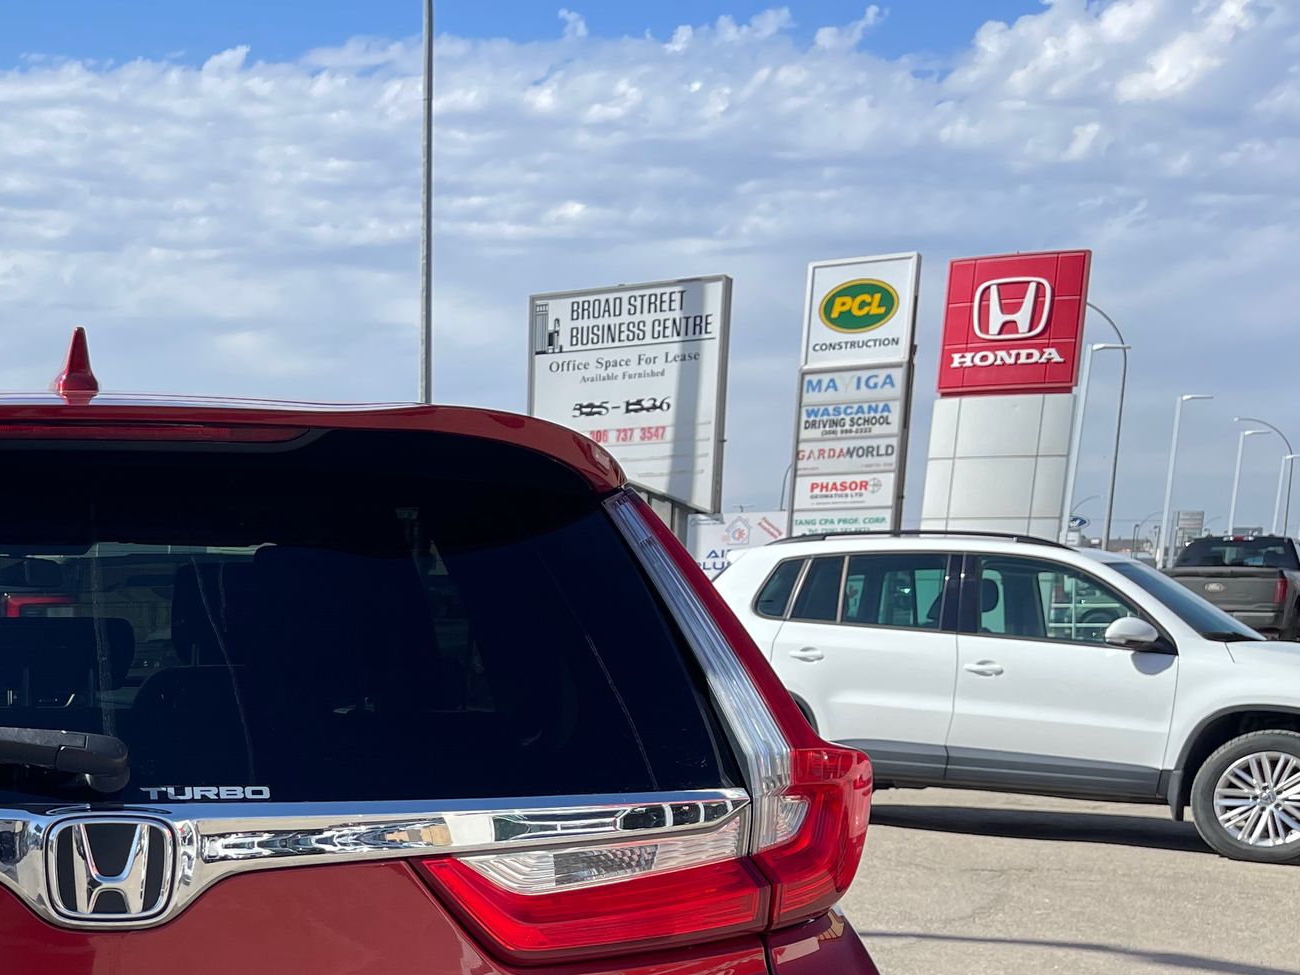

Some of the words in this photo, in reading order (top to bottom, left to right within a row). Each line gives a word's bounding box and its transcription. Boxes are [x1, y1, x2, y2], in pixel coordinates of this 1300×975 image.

[570, 297, 622, 321] BROAD
[627, 290, 687, 315] STREET
[830, 292, 886, 319] PCL
[570, 320, 646, 347] BUSINESS
[651, 313, 713, 340] CENTRE
[812, 337, 900, 352] CONSTRUCTION
[549, 359, 590, 373] Office
[595, 357, 631, 370] Space
[637, 353, 659, 366] For
[664, 351, 701, 364] Lease
[950, 348, 1065, 369] HONDA
[579, 372, 619, 384] Available
[622, 368, 666, 380] Furnished
[805, 403, 891, 418] WASCANA
[804, 417, 846, 430] DRIVING
[849, 415, 892, 428] SCHOOL
[615, 428, 634, 442] 737
[640, 426, 666, 441] 3547
[810, 480, 869, 493] PHASOR
[140, 786, 270, 800] TURBO
